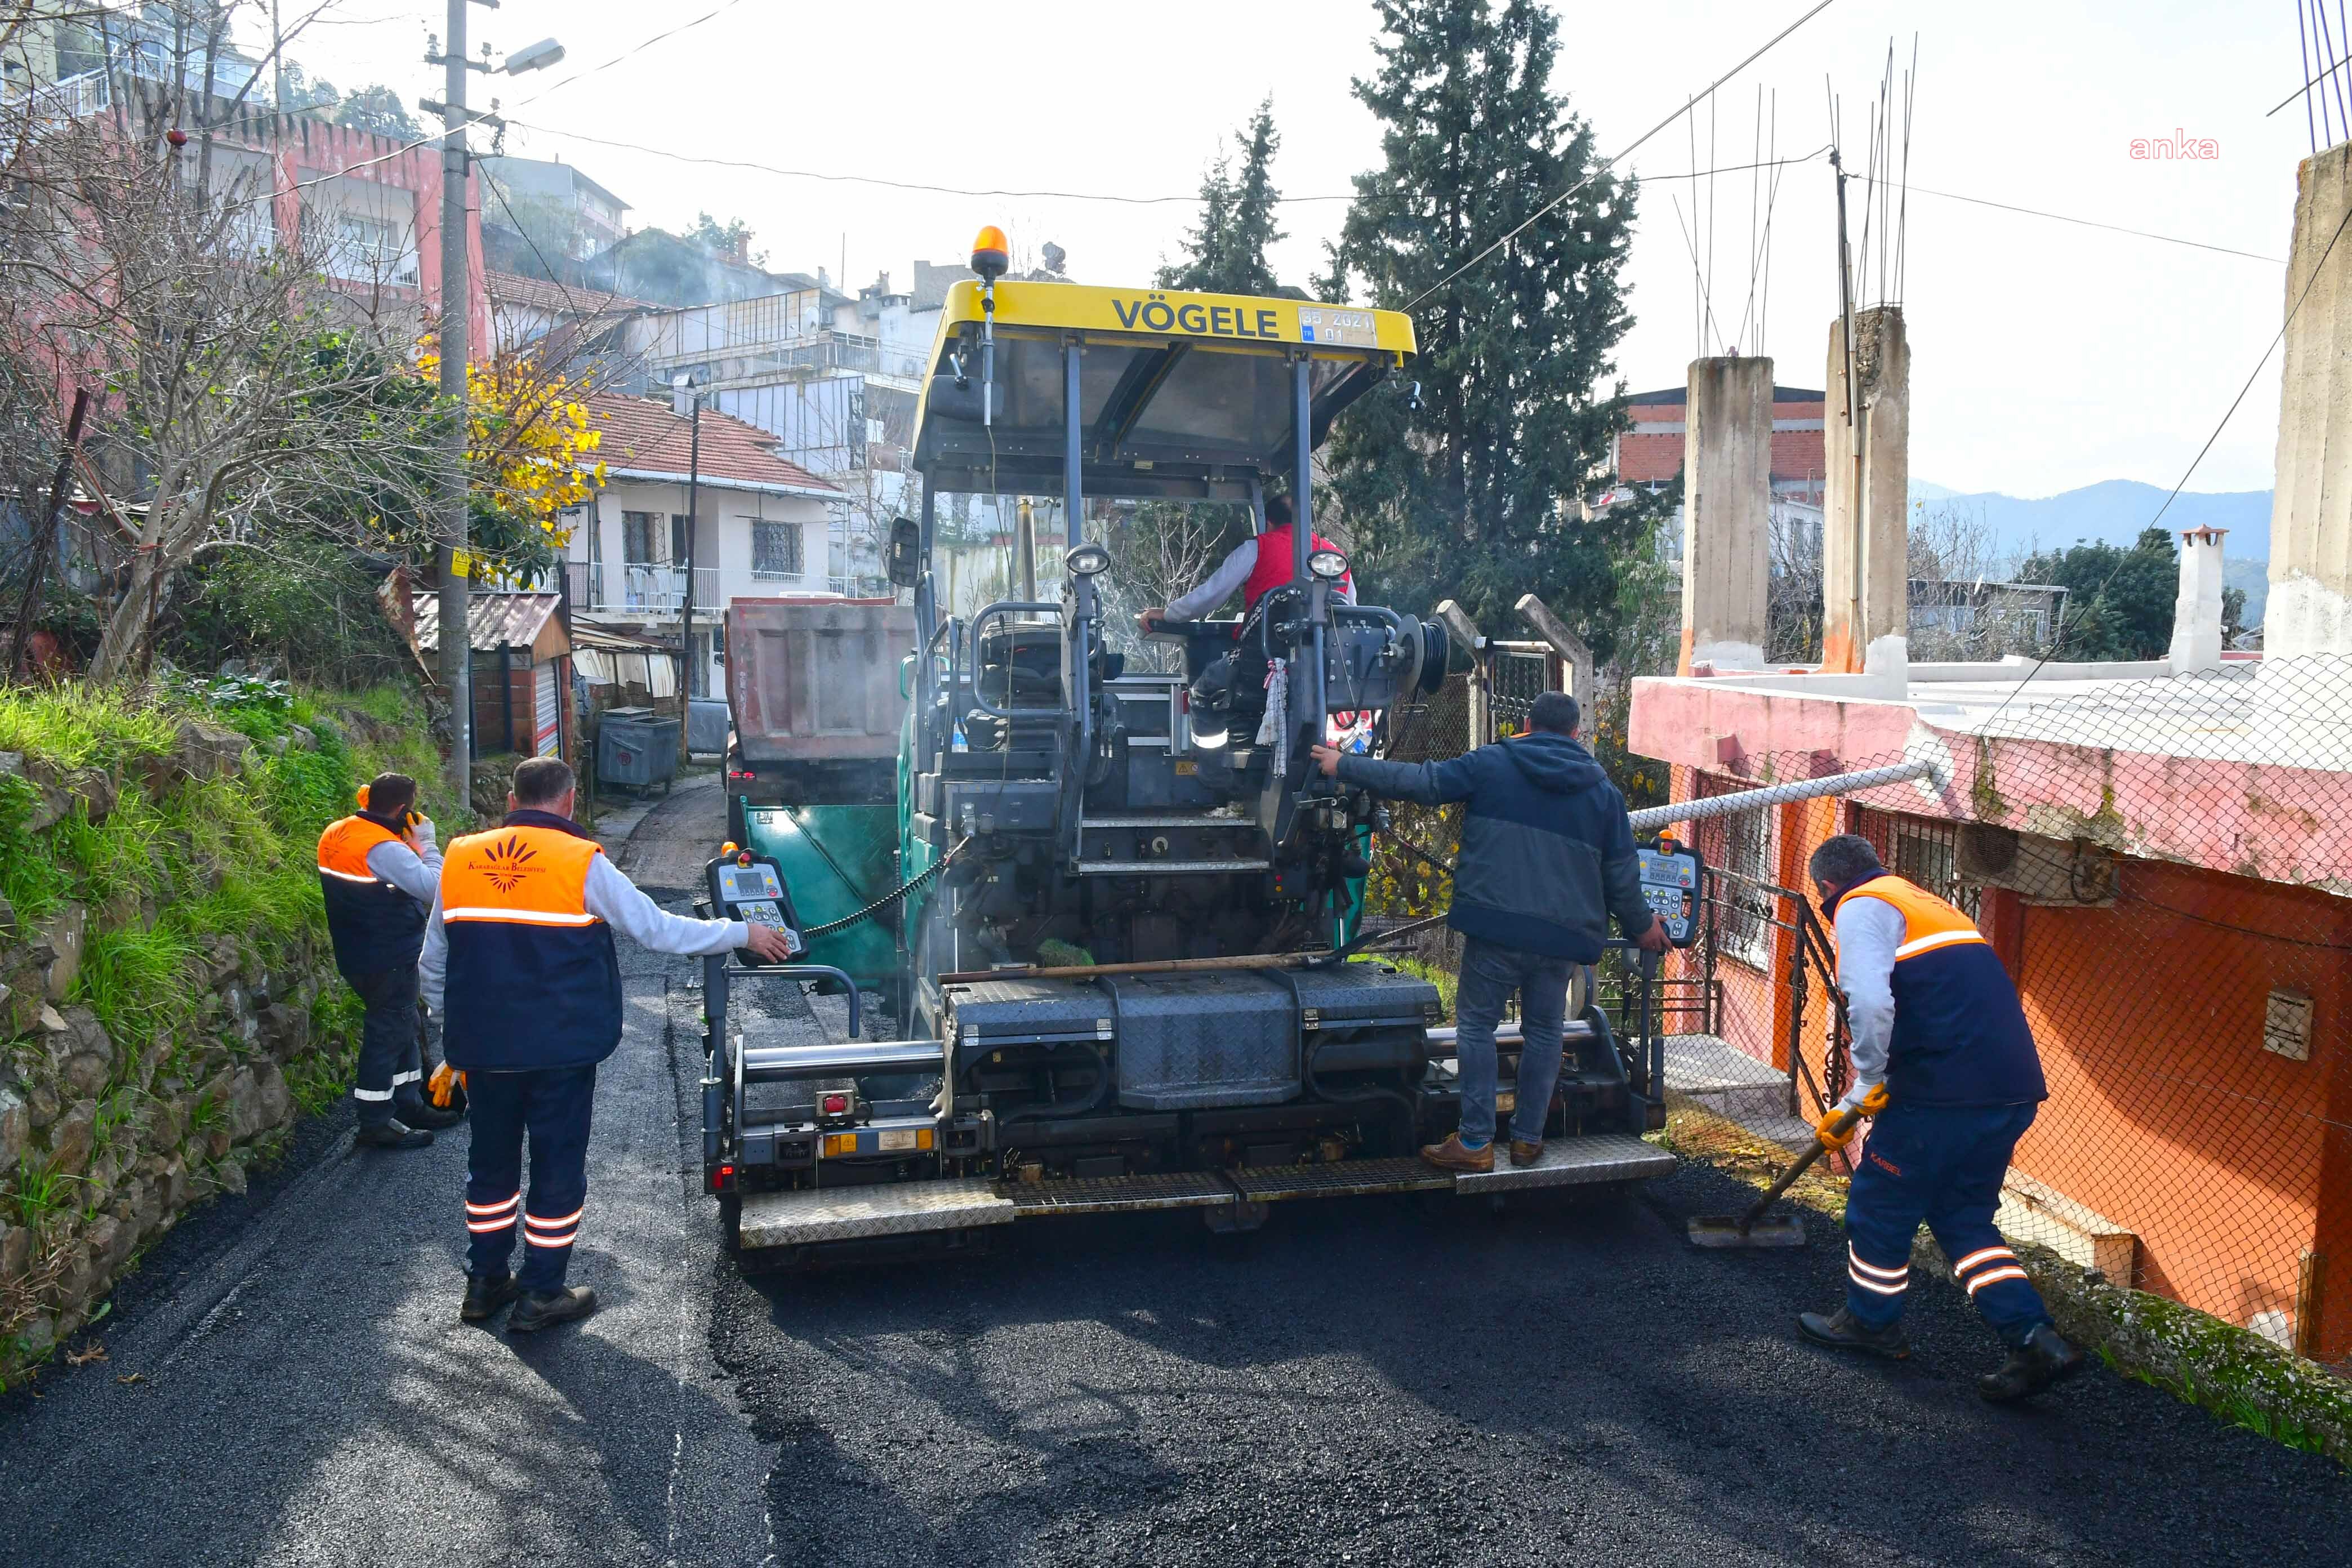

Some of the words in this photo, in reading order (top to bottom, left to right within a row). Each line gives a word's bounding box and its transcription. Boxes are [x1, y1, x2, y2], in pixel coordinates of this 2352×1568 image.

[1111, 293, 1280, 338] VÖGELE
[1333, 313, 1370, 329] 2021
[1870, 1152, 1902, 1177] KARBEL
